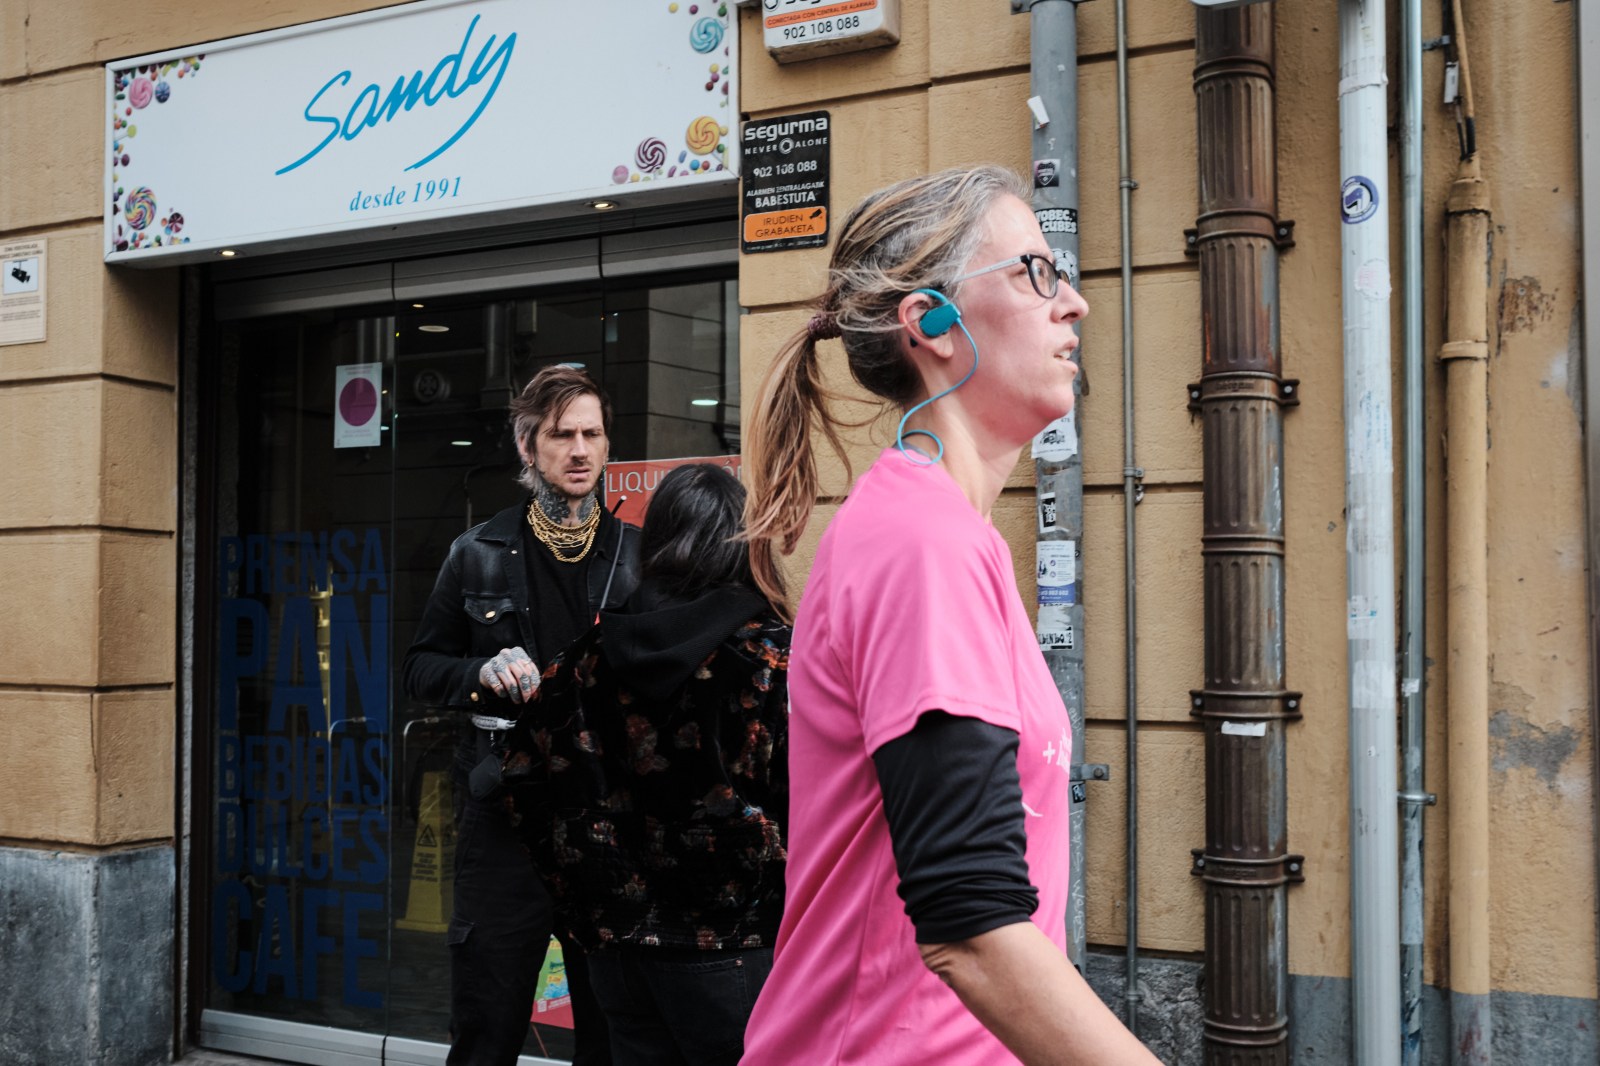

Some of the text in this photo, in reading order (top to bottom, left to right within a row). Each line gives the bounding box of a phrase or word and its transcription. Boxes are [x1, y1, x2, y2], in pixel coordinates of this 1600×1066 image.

[784, 26, 806, 40] 902
[810, 21, 833, 35] 108
[837, 16, 860, 31] 088
[275, 14, 517, 175] Sandy
[745, 117, 828, 142] segurma
[744, 137, 828, 155] NEVER ALONE
[753, 160, 818, 178] 902 108 088
[349, 176, 462, 211] desde 1991
[755, 191, 816, 209] BABESTUTA
[755, 224, 815, 238] GRABAKETA
[763, 214, 804, 226] IRUDIEN
[219, 527, 388, 598] PRENSA
[219, 594, 388, 734] PAN
[219, 733, 388, 805] BEBIDAS
[219, 802, 388, 884] DULCES
[213, 878, 384, 1009] CAFE
